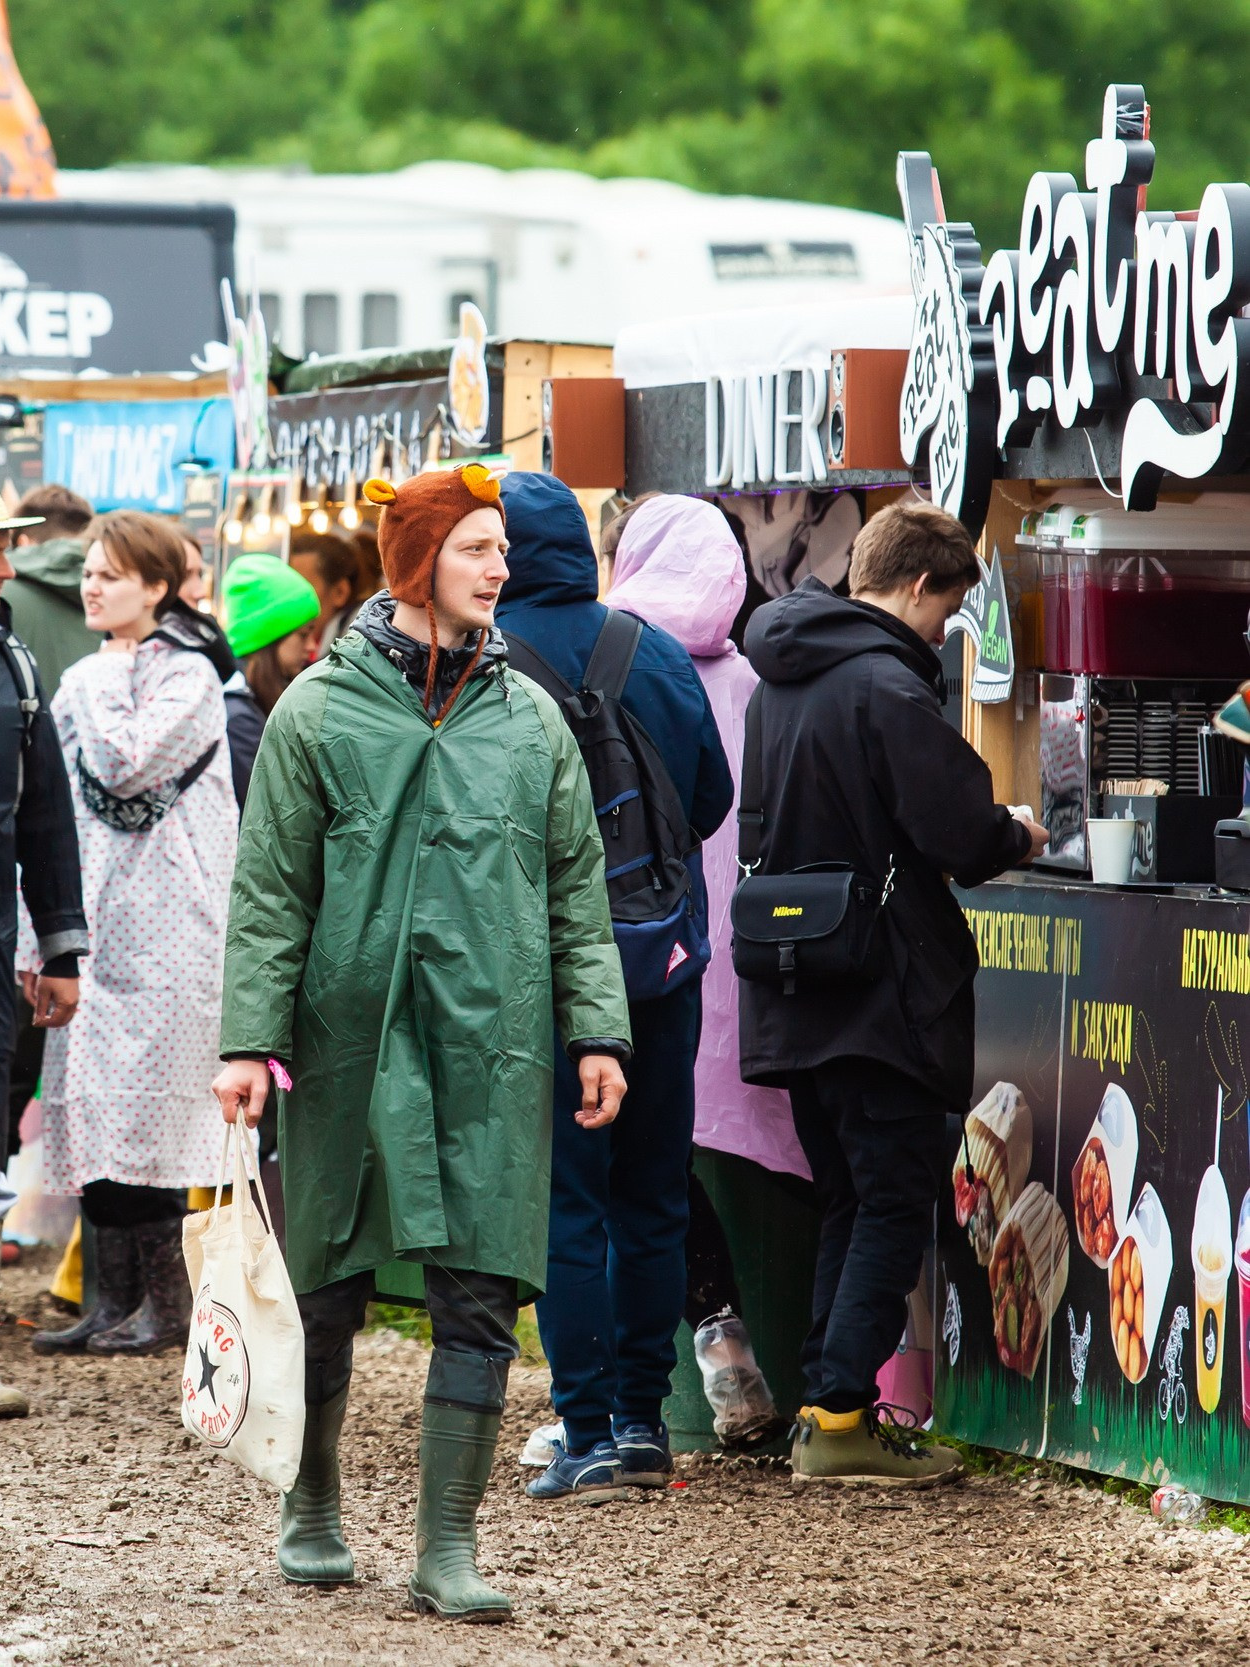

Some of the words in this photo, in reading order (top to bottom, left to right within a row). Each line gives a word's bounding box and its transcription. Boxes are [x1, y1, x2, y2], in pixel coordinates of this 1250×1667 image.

[705, 365, 827, 489] DINER
[981, 630, 1009, 666] VEGAN
[772, 906, 803, 917] Nikon
[1053, 917, 1082, 976] ПИТЫ
[1070, 998, 1079, 1058] И
[1082, 1000, 1133, 1076] ЗАКУСКИ
[200, 1403, 232, 1436] PAULI
[594, 1448, 619, 1457] Reebo
